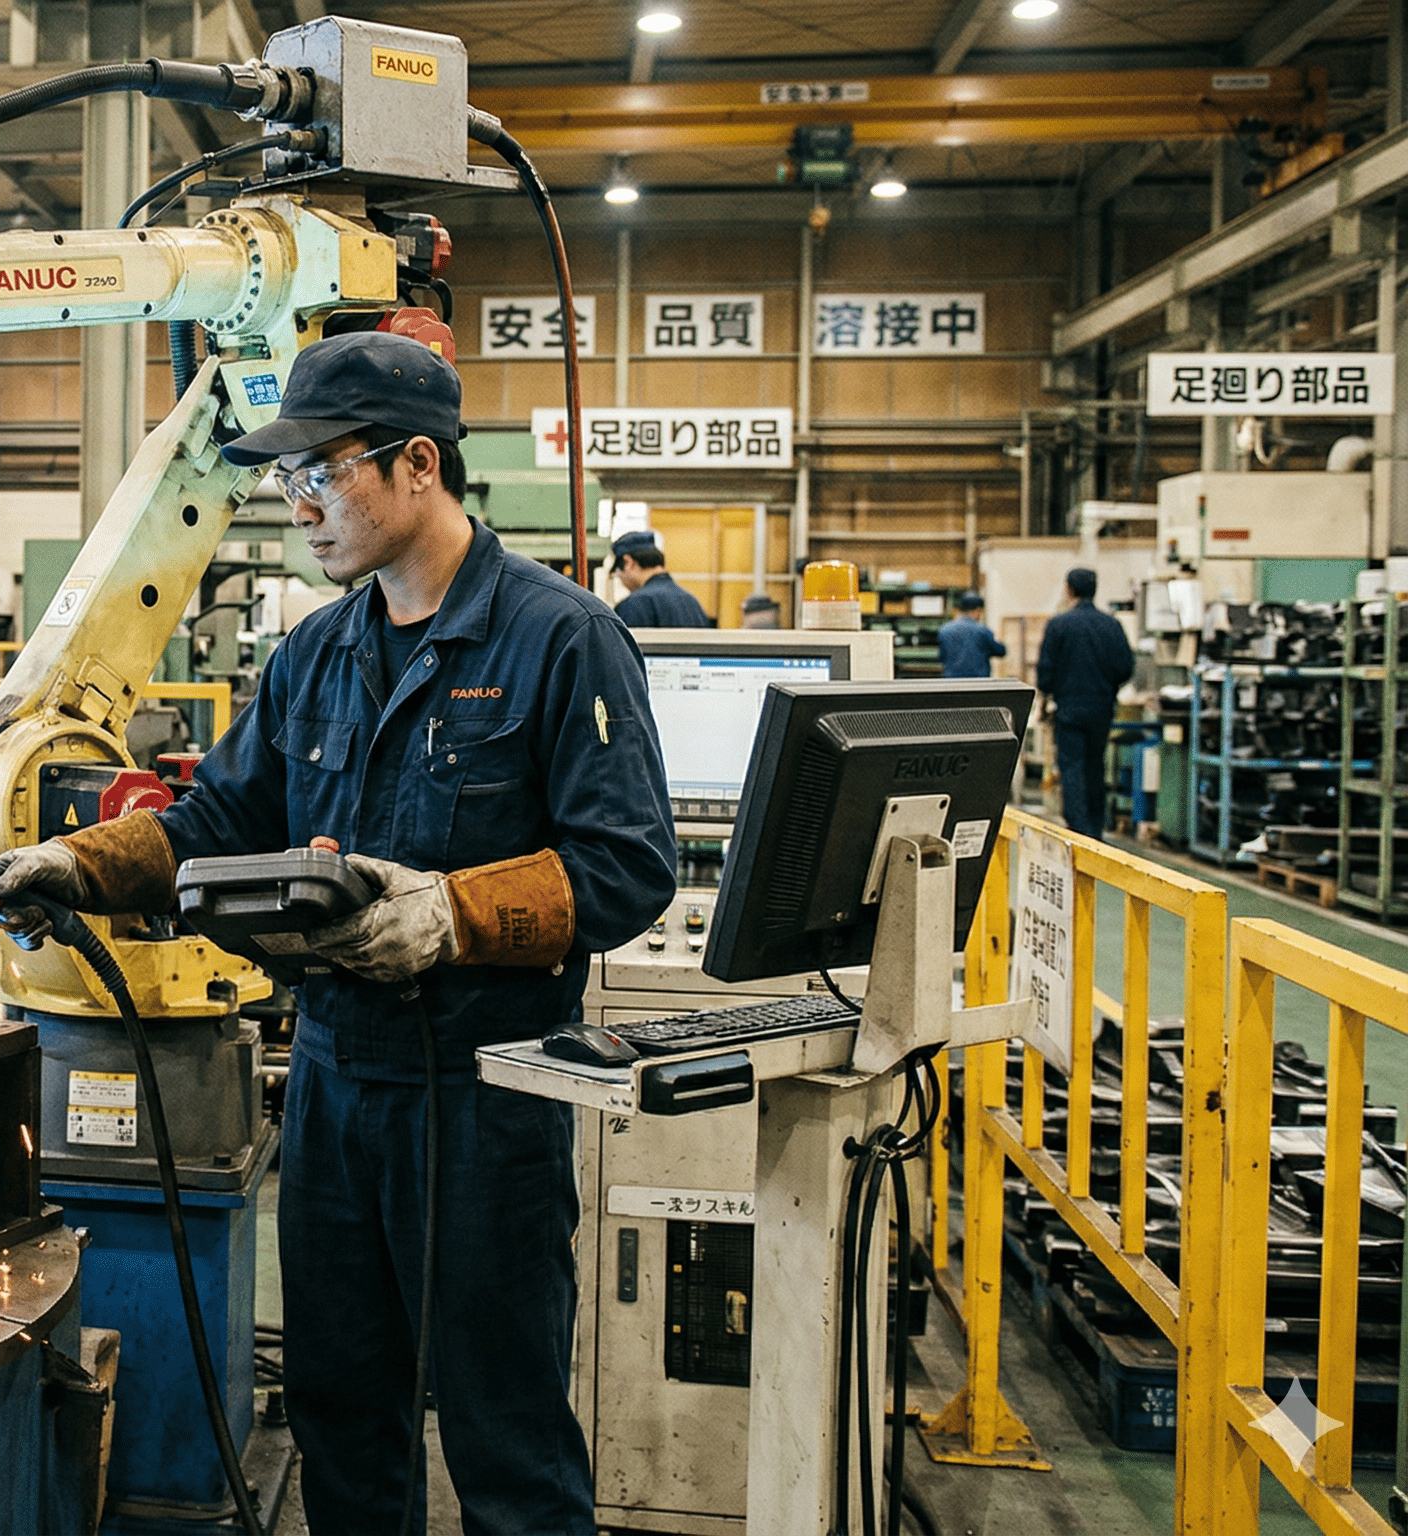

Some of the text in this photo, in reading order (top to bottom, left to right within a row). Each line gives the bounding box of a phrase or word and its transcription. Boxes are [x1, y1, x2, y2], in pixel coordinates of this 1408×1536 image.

[377, 55, 433, 77] FANUC
[489, 304, 587, 348] 安全
[655, 302, 754, 347] 品質
[817, 301, 976, 347] 溶接中
[1172, 365, 1369, 404] 足廻り部品
[587, 419, 781, 456] 足廻り部品
